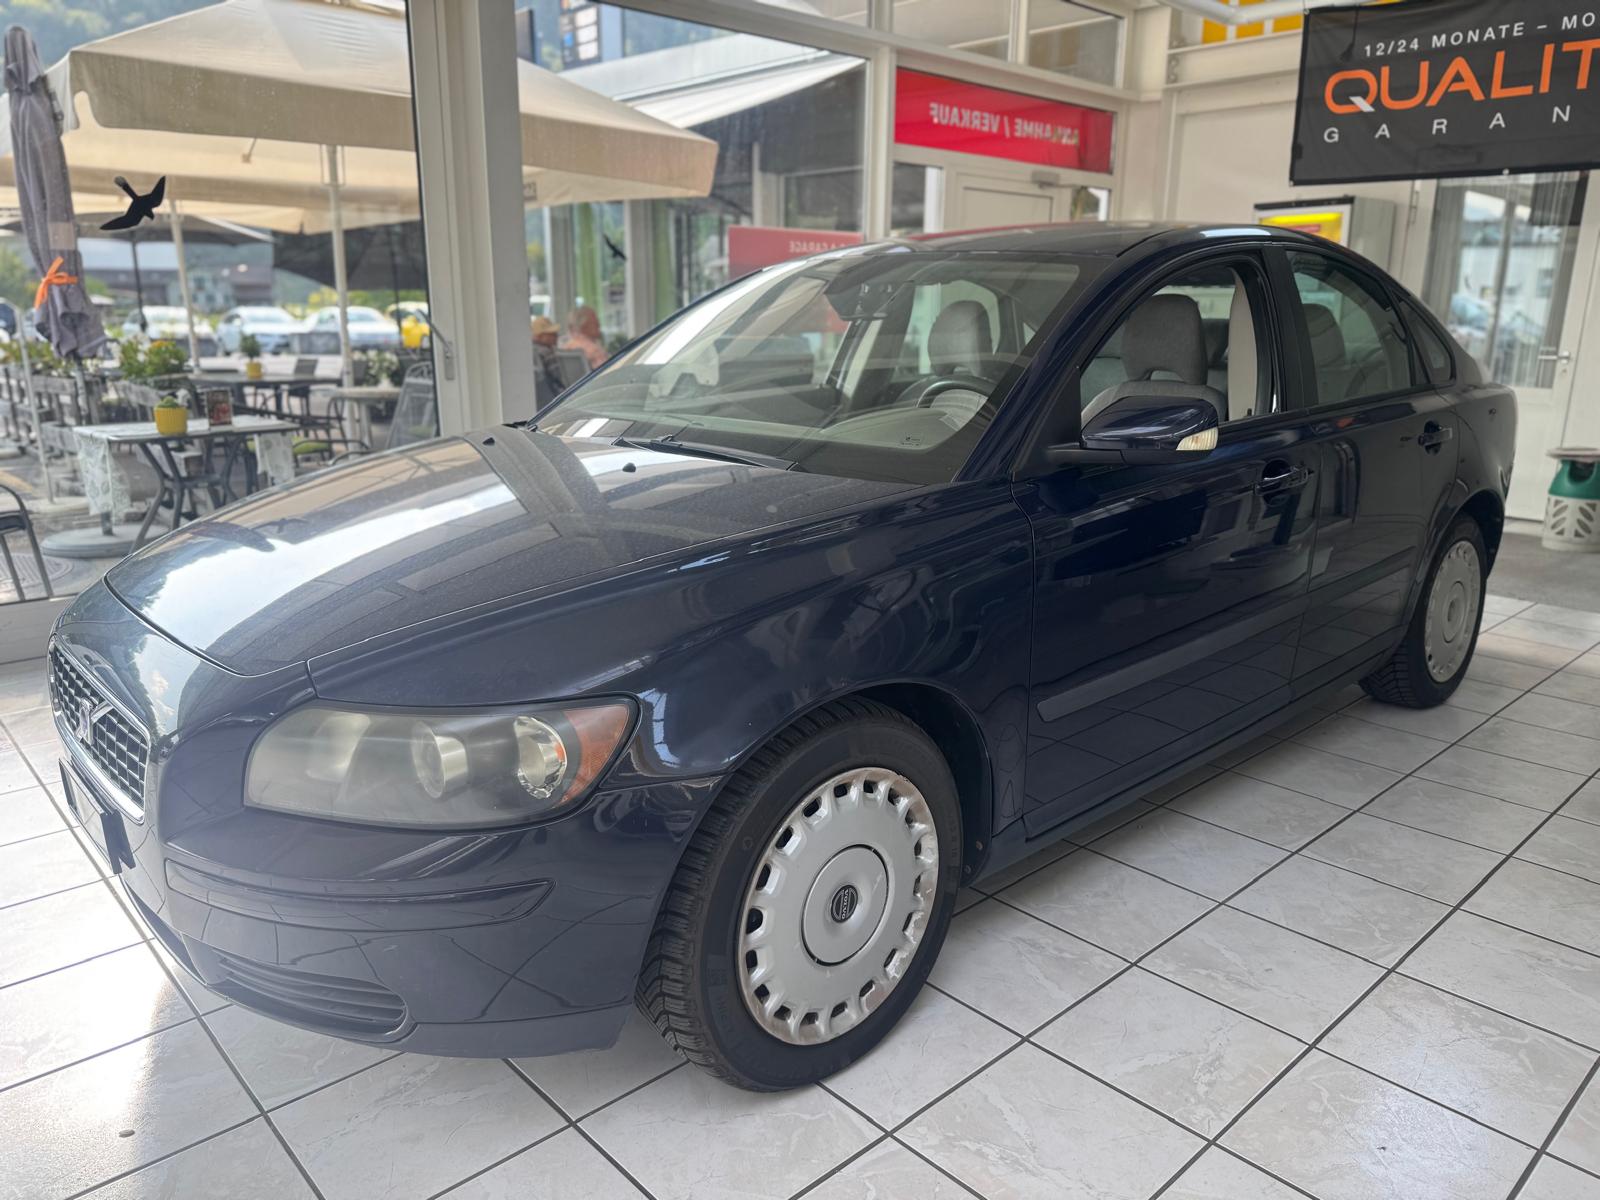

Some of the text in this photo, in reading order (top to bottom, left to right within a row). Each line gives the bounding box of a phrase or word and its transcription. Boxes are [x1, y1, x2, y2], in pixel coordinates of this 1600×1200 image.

[1364, 37, 1419, 57] 12/24
[1432, 22, 1525, 48] MONATE
[1562, 12, 1596, 30] MO
[1324, 38, 1600, 114] QUALIT
